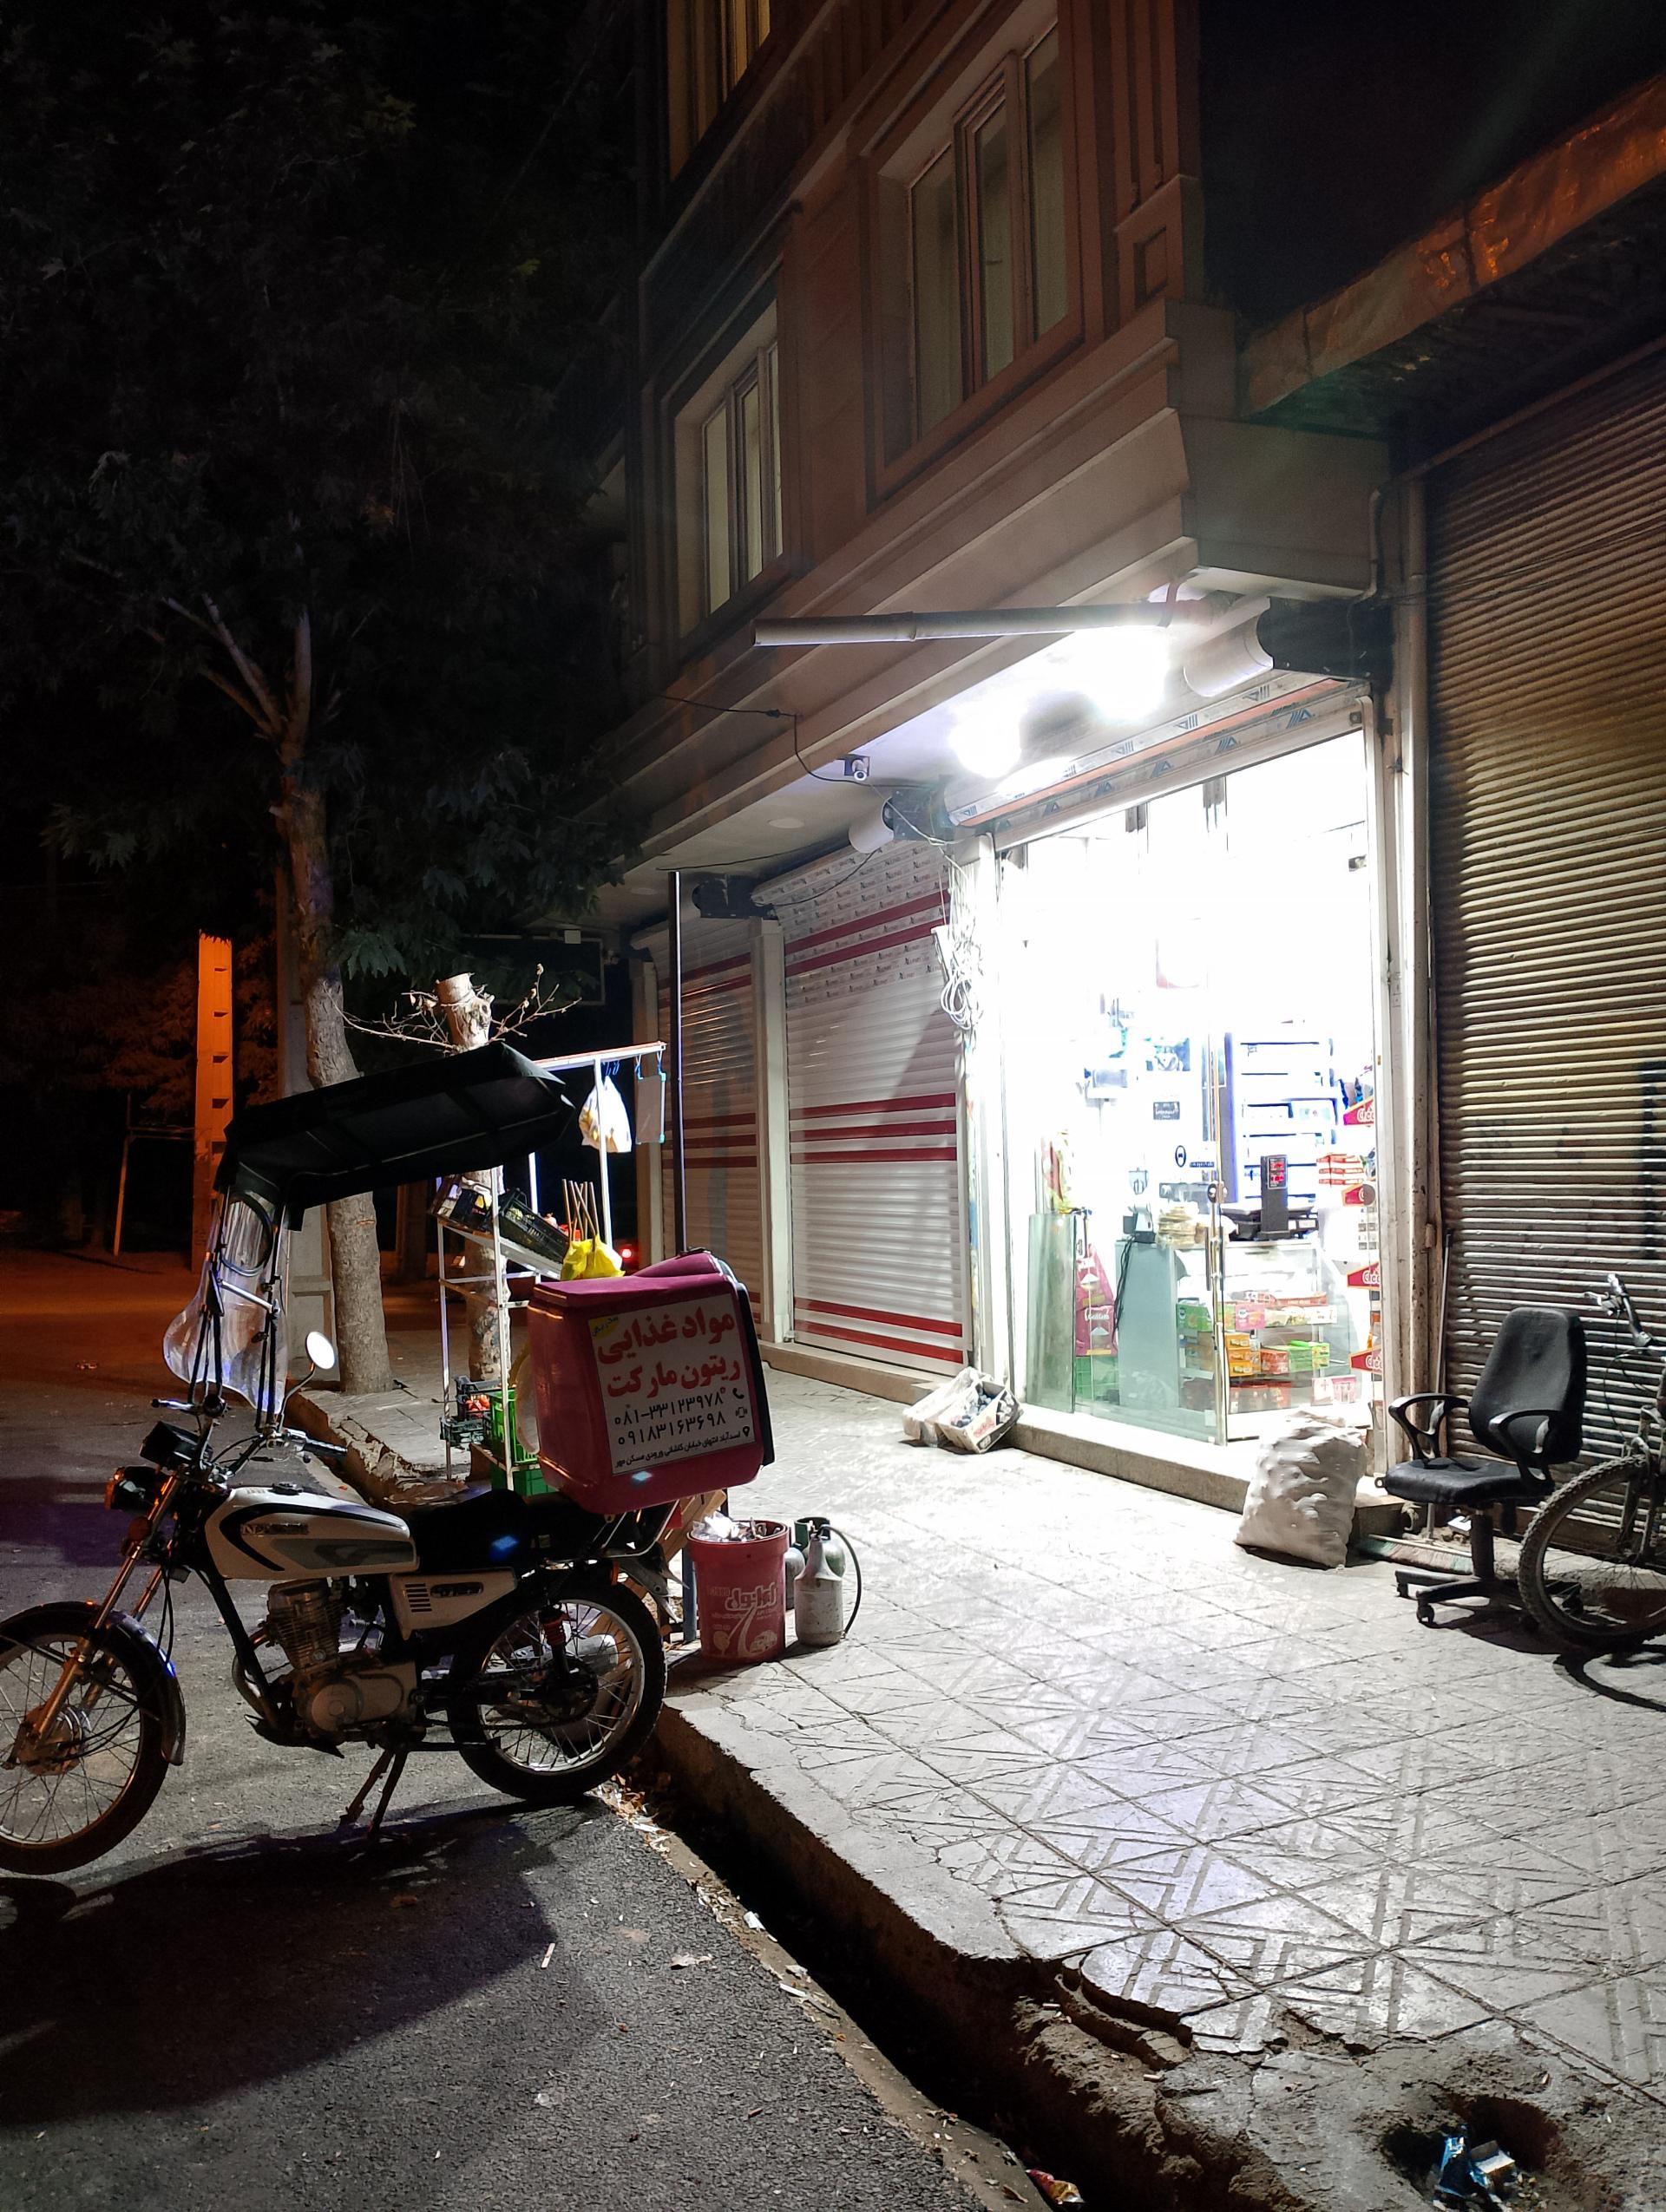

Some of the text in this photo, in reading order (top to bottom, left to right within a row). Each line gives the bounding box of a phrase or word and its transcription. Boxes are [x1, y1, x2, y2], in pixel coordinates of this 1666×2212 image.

[597, 1306, 735, 1365] مواد غذایی
[607, 1360, 678, 1398] مارکت
[618, 1410, 726, 1446] ۰۹۱۸۳۱۶۳۶۹۸
[626, 1453, 645, 1466] مسکن
[685, 1441, 702, 1452] خیابان
